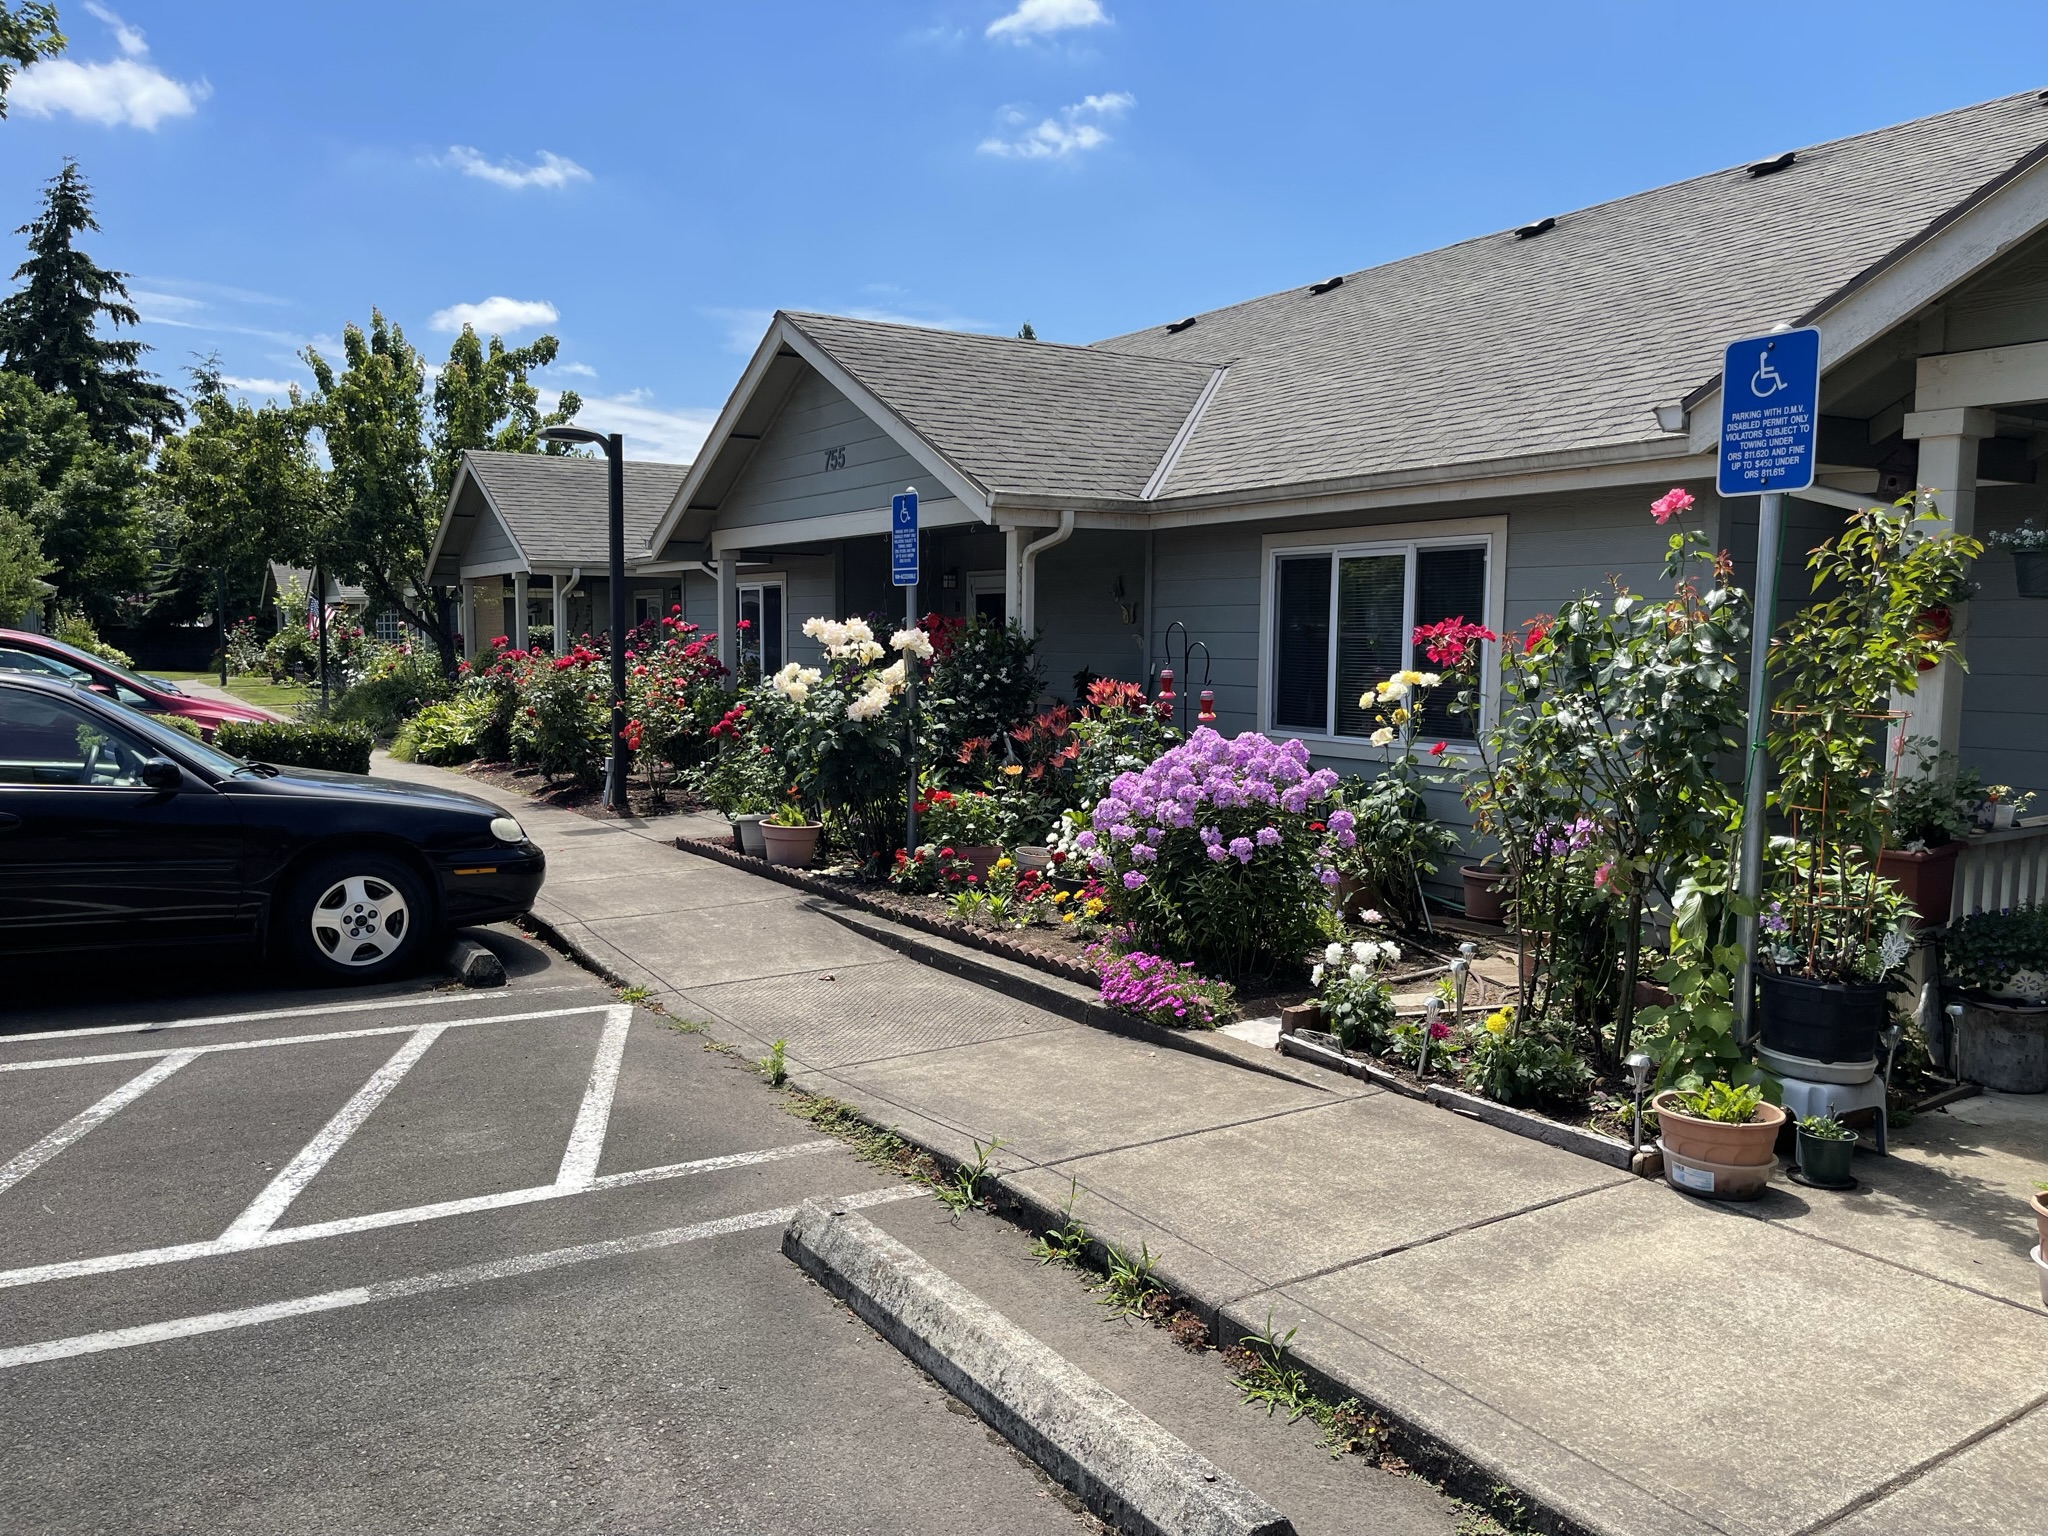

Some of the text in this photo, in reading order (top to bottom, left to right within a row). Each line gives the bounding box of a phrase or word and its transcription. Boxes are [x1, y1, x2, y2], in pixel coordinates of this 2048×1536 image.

[1732, 405, 1805, 421] PARKING WITH D.M.V.
[1727, 414, 1809, 432] DISABLED PERMIT ONLY
[1726, 425, 1810, 441] VIOLATORS SUBJECT TO
[1740, 437, 1794, 450] TOWING UNDER
[825, 447, 846, 472] 755
[1728, 445, 1805, 461] ORS 811.620 AND FINE
[1732, 456, 1800, 470] UP TO $450 UNDER
[1744, 468, 1786, 479] ORS 811.615
